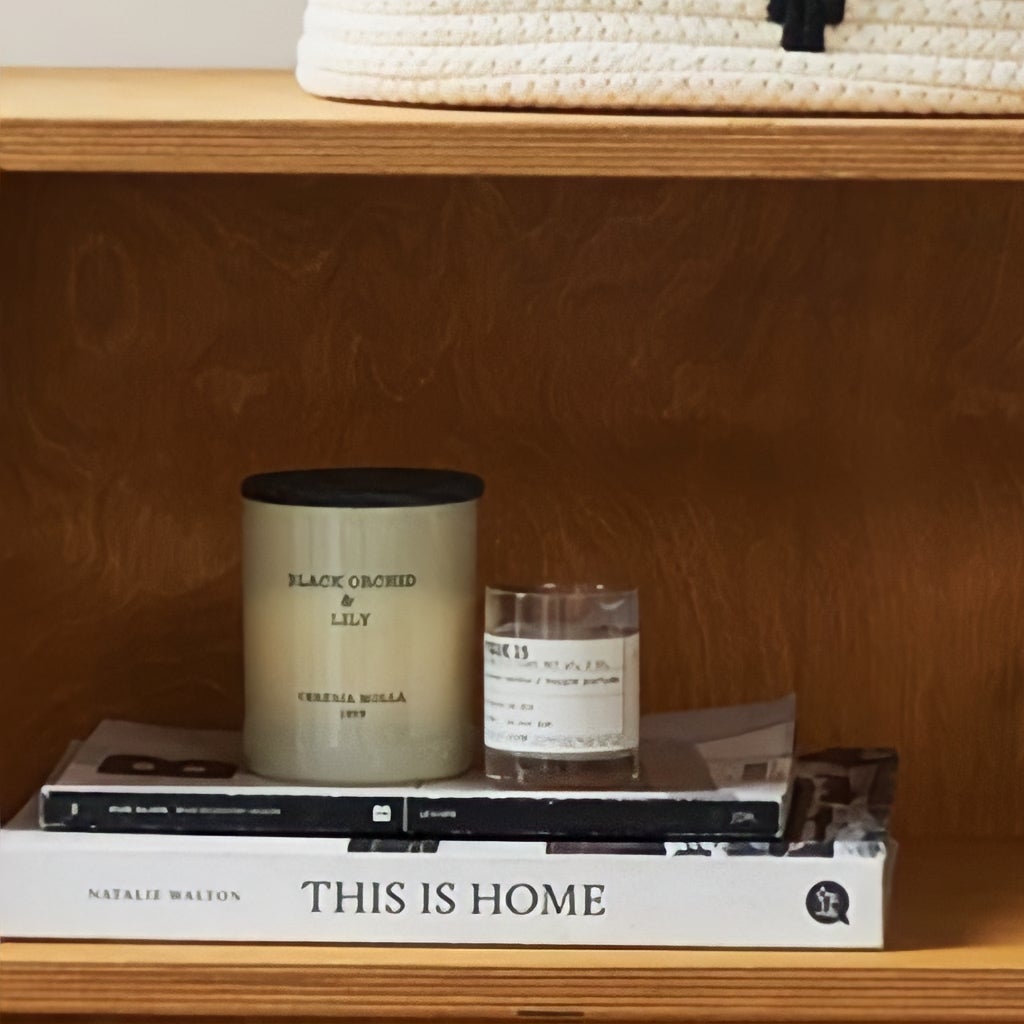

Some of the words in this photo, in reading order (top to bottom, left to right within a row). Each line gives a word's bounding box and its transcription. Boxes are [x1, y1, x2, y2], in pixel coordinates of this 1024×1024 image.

[287, 573, 344, 588] BLACK
[348, 573, 417, 588] ORCHID
[330, 612, 371, 626] LILY
[88, 887, 160, 901] NATALIE
[168, 889, 241, 901] WALTON
[300, 880, 406, 914] THIS
[421, 882, 456, 915] IS
[470, 883, 606, 916] HOME
